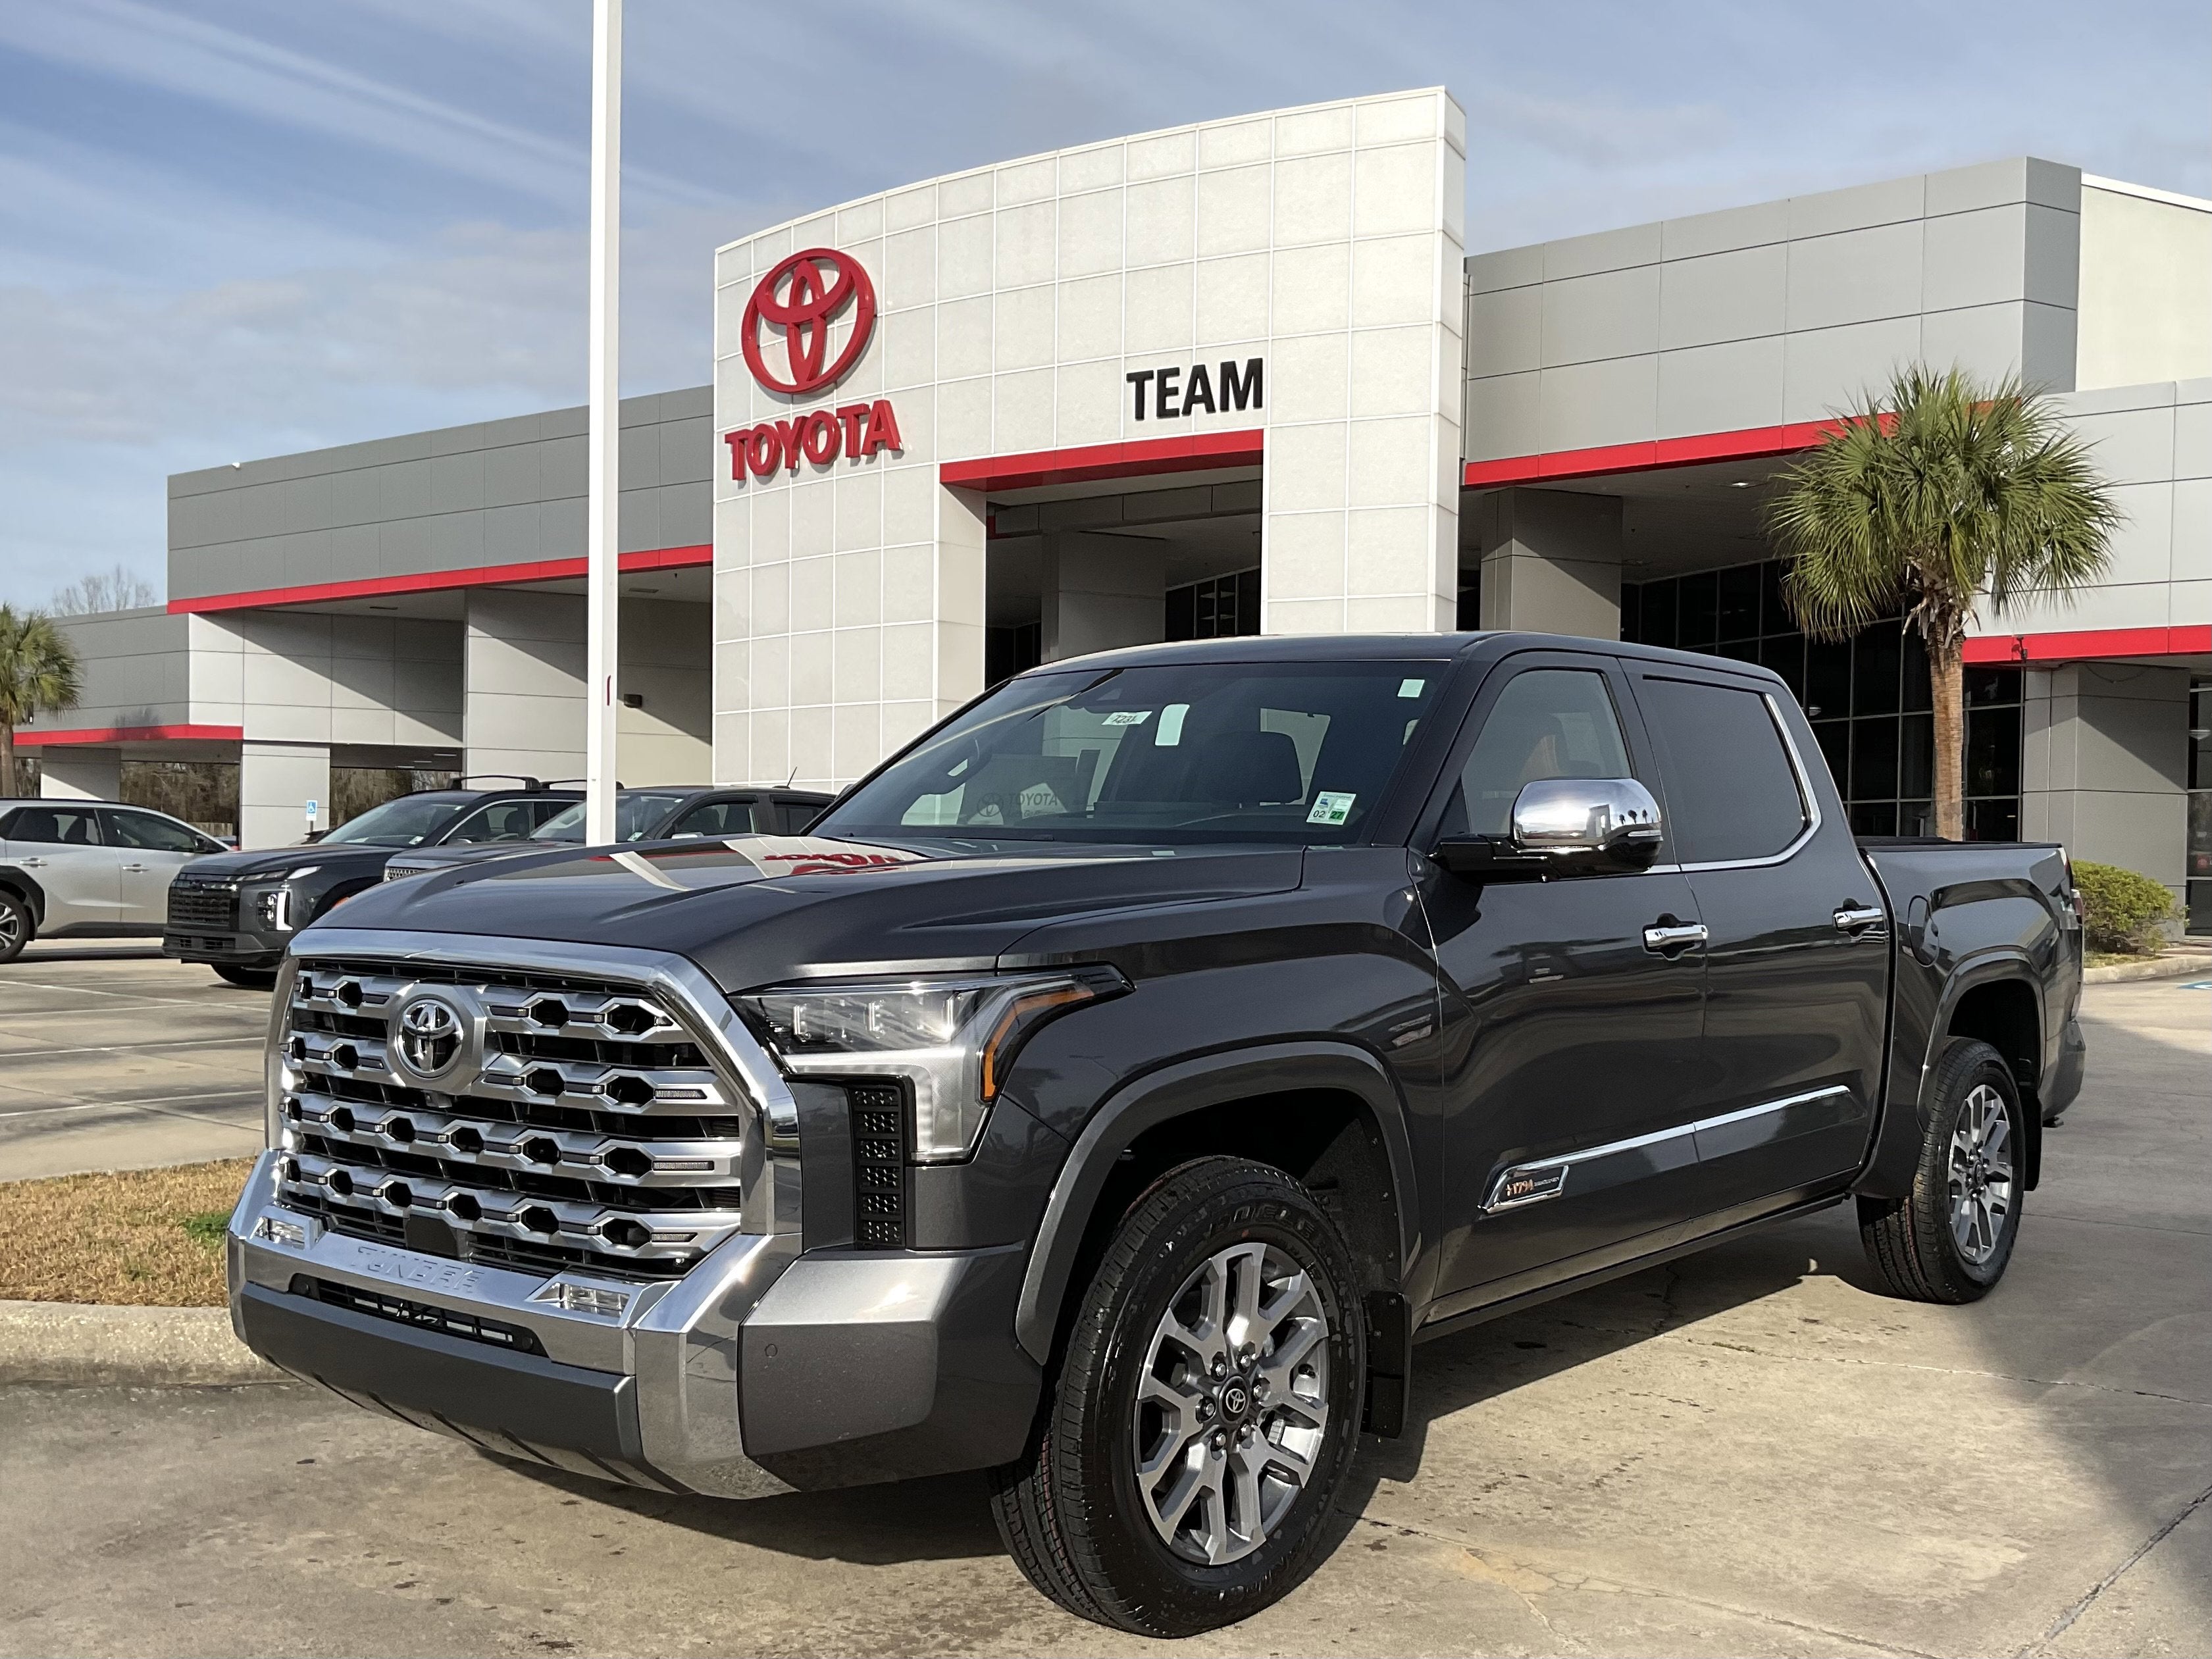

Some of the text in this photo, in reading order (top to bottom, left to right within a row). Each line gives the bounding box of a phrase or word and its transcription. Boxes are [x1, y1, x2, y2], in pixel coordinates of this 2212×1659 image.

[1126, 357, 1263, 421] TEAM
[725, 399, 902, 480] TOYOTA
[1330, 811, 1343, 819] 27
